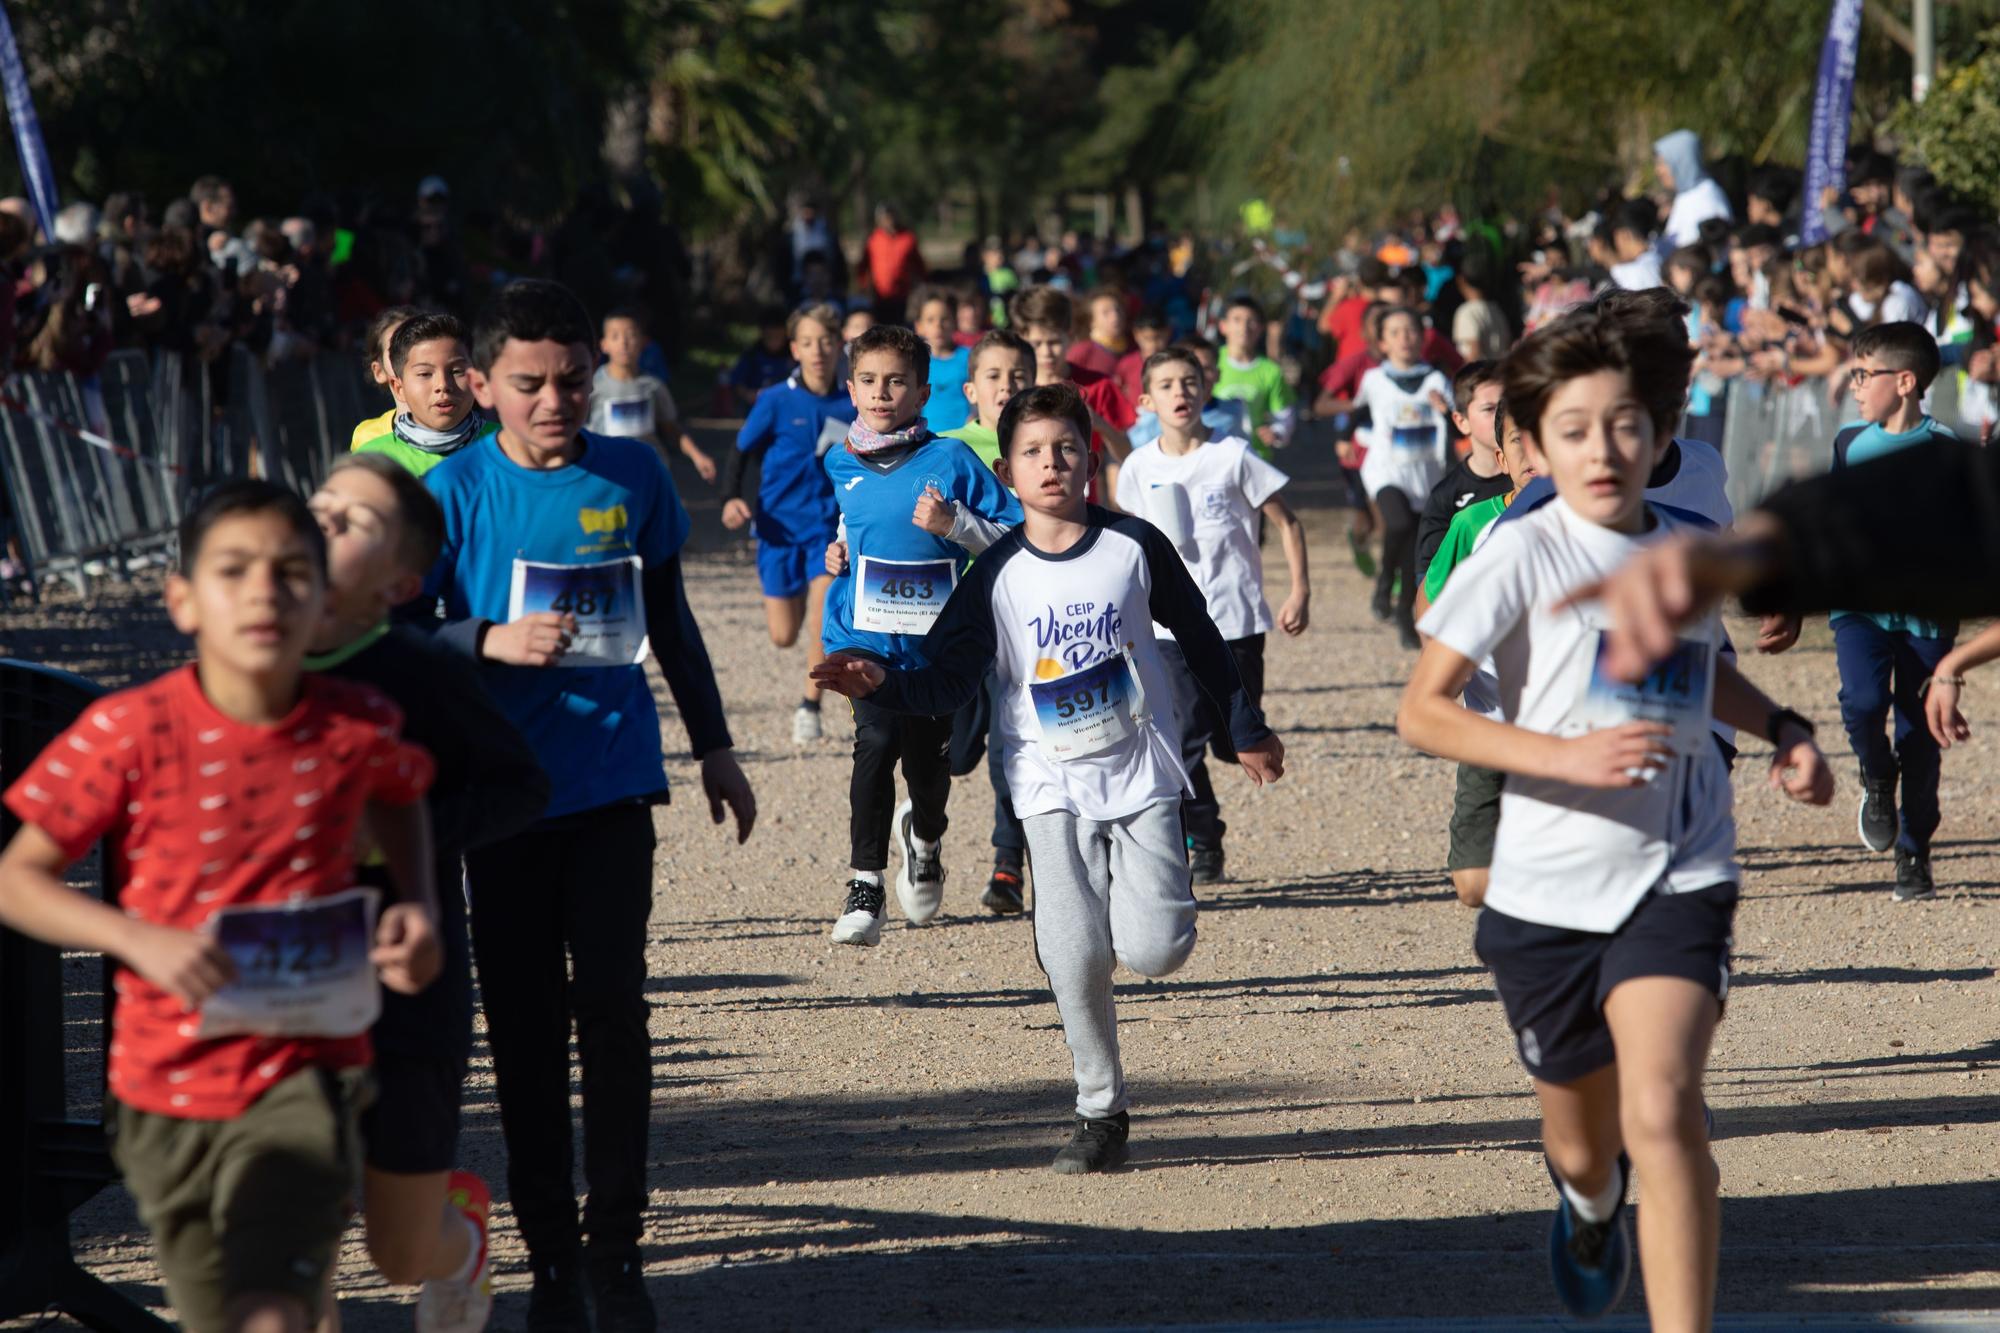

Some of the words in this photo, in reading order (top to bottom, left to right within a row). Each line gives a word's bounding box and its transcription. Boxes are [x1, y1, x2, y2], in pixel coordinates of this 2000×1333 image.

[881, 579, 933, 599] 463
[551, 588, 615, 615] 487
[1066, 602, 1095, 616] CEIP
[1028, 602, 1122, 649] Vicente
[1055, 679, 1109, 719] 597
[1073, 722, 1101, 735] Vicente
